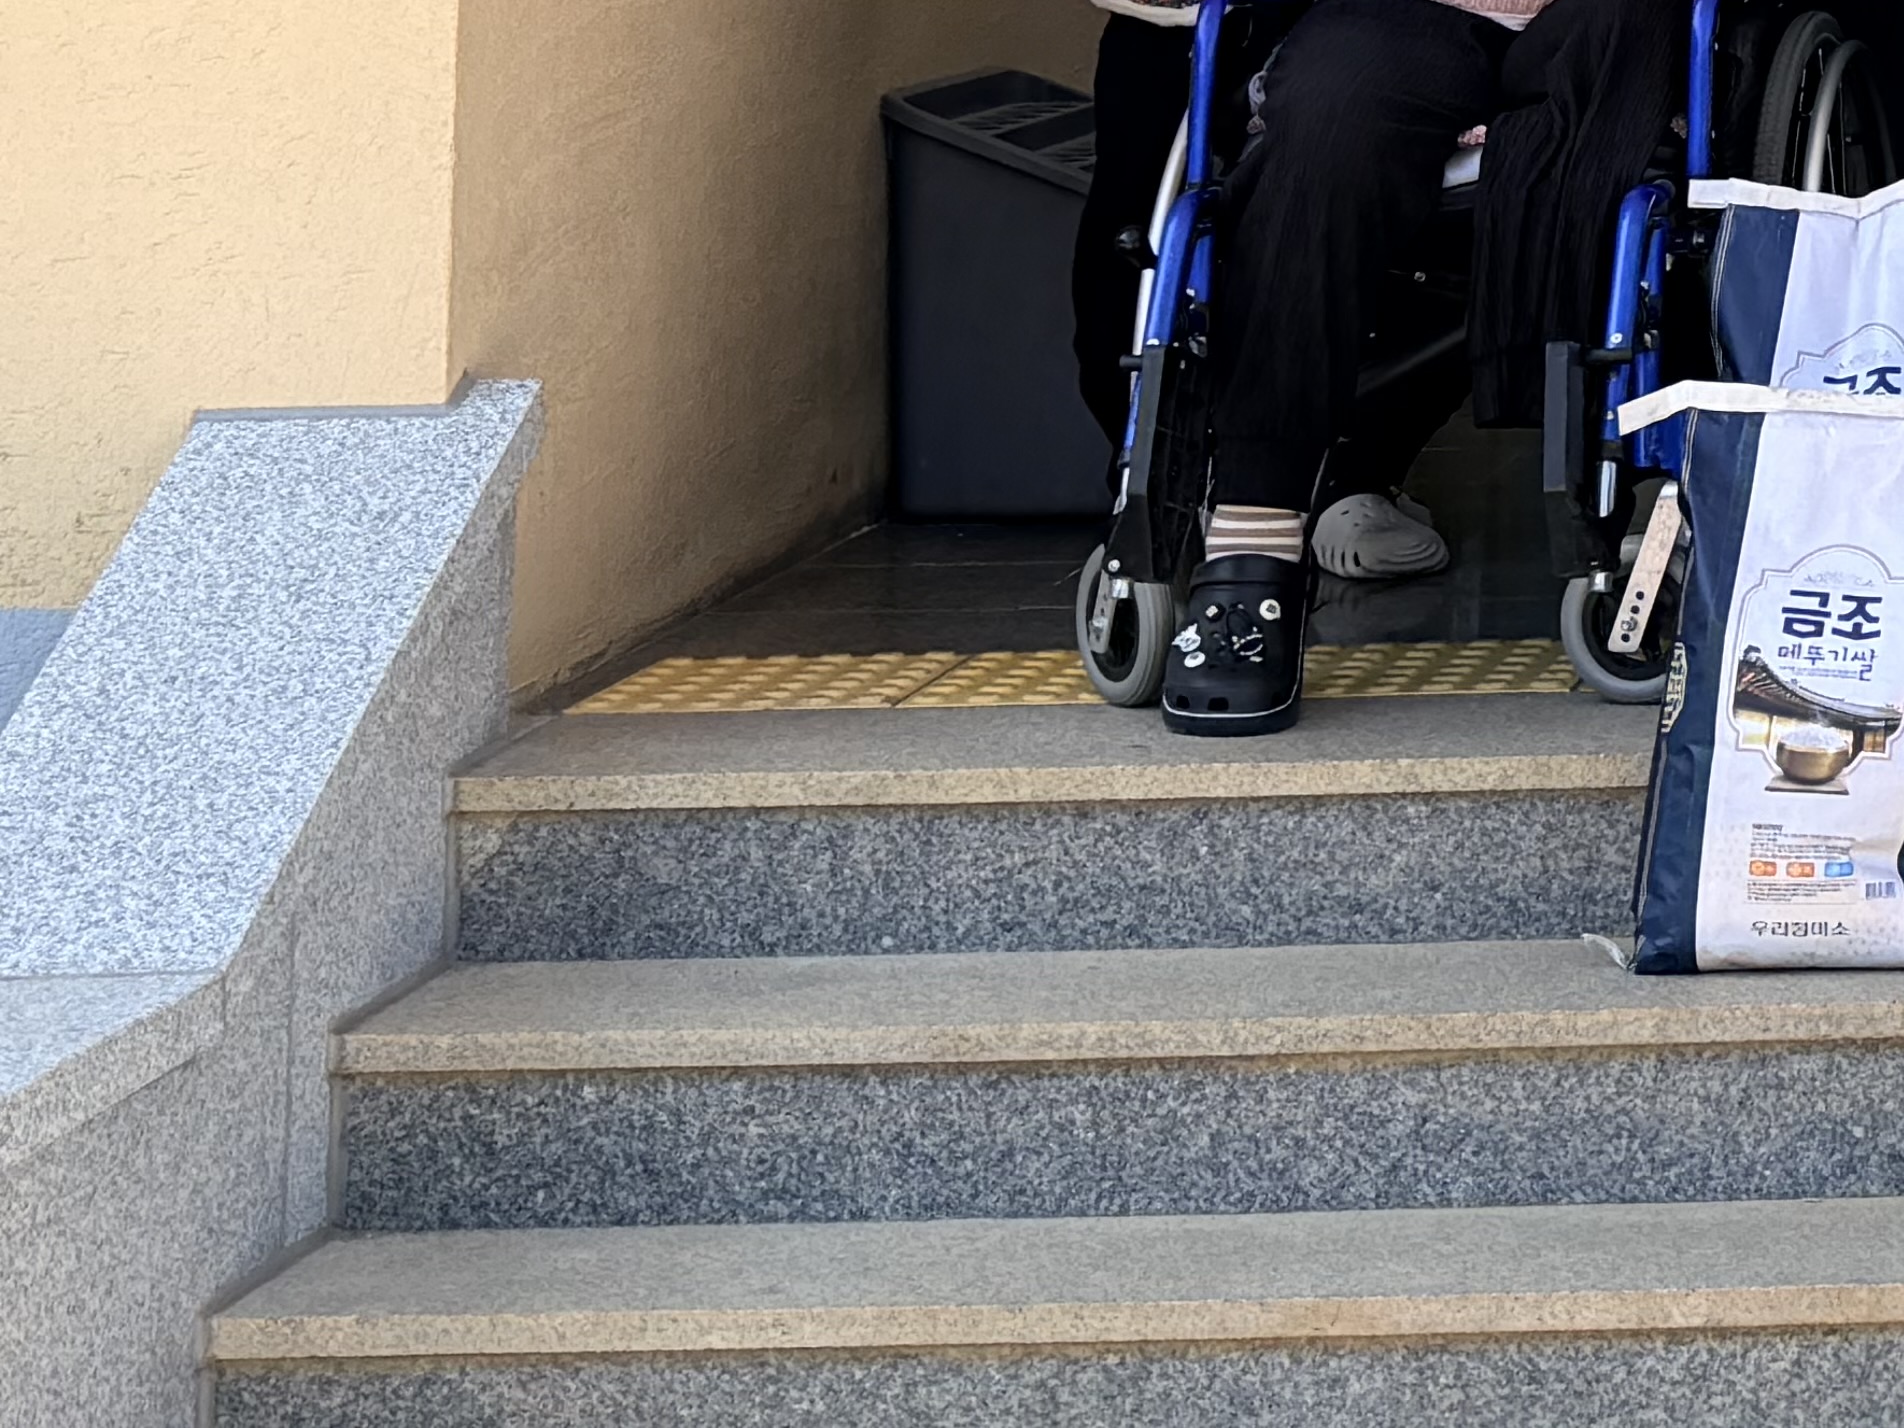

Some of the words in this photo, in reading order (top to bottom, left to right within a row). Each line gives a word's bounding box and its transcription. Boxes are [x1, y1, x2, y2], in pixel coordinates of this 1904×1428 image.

[1781, 589, 1883, 640] 금조
[1777, 642, 1879, 681] 메뚜기쌀
[1751, 920, 1851, 937] 우리정미소
